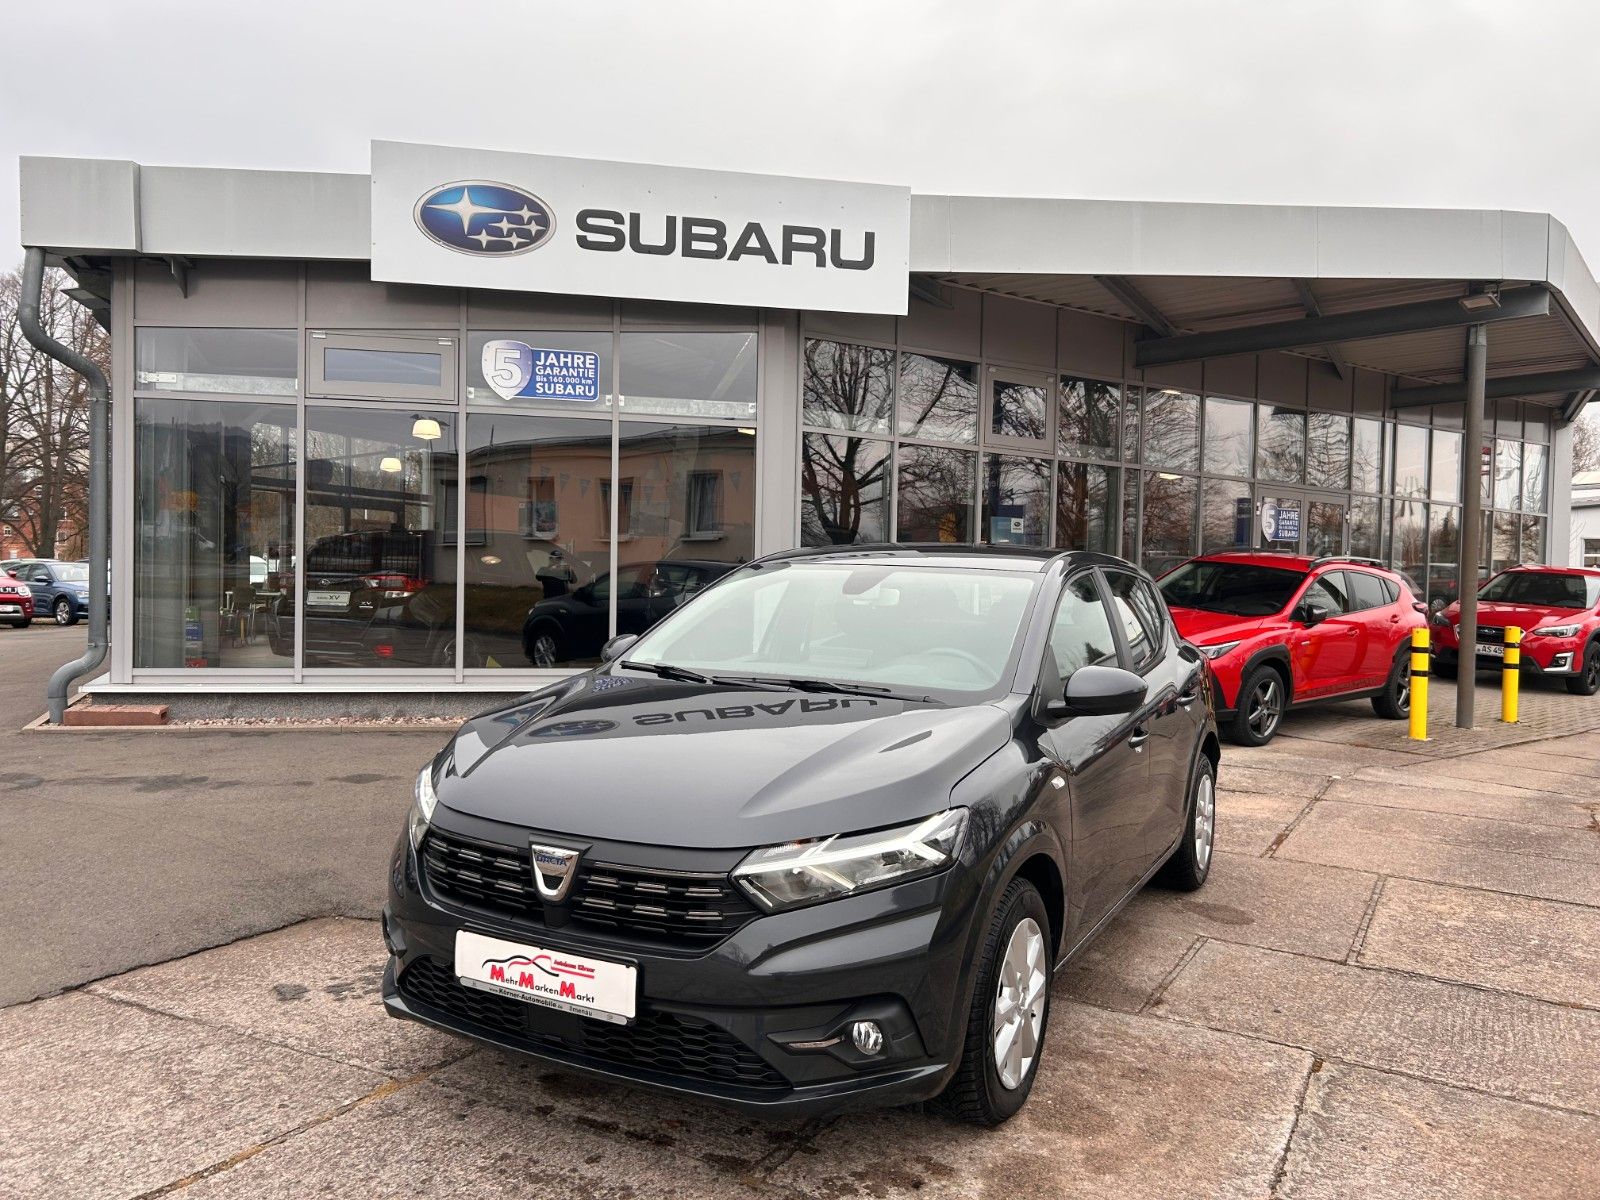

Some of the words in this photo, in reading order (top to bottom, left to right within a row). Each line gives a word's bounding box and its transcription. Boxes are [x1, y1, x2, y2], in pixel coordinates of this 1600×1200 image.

[576, 208, 875, 270] SUBARU
[536, 352, 595, 368] JAHRE
[492, 348, 522, 388] 5
[536, 366, 595, 377] GARANTIE
[549, 376, 580, 384] 160.000
[536, 382, 595, 396] SUBARU
[1266, 509, 1275, 534] 5
[1279, 511, 1298, 520] JAHRE
[1482, 645, 1492, 653] AS
[1493, 646, 1504, 655] 45
